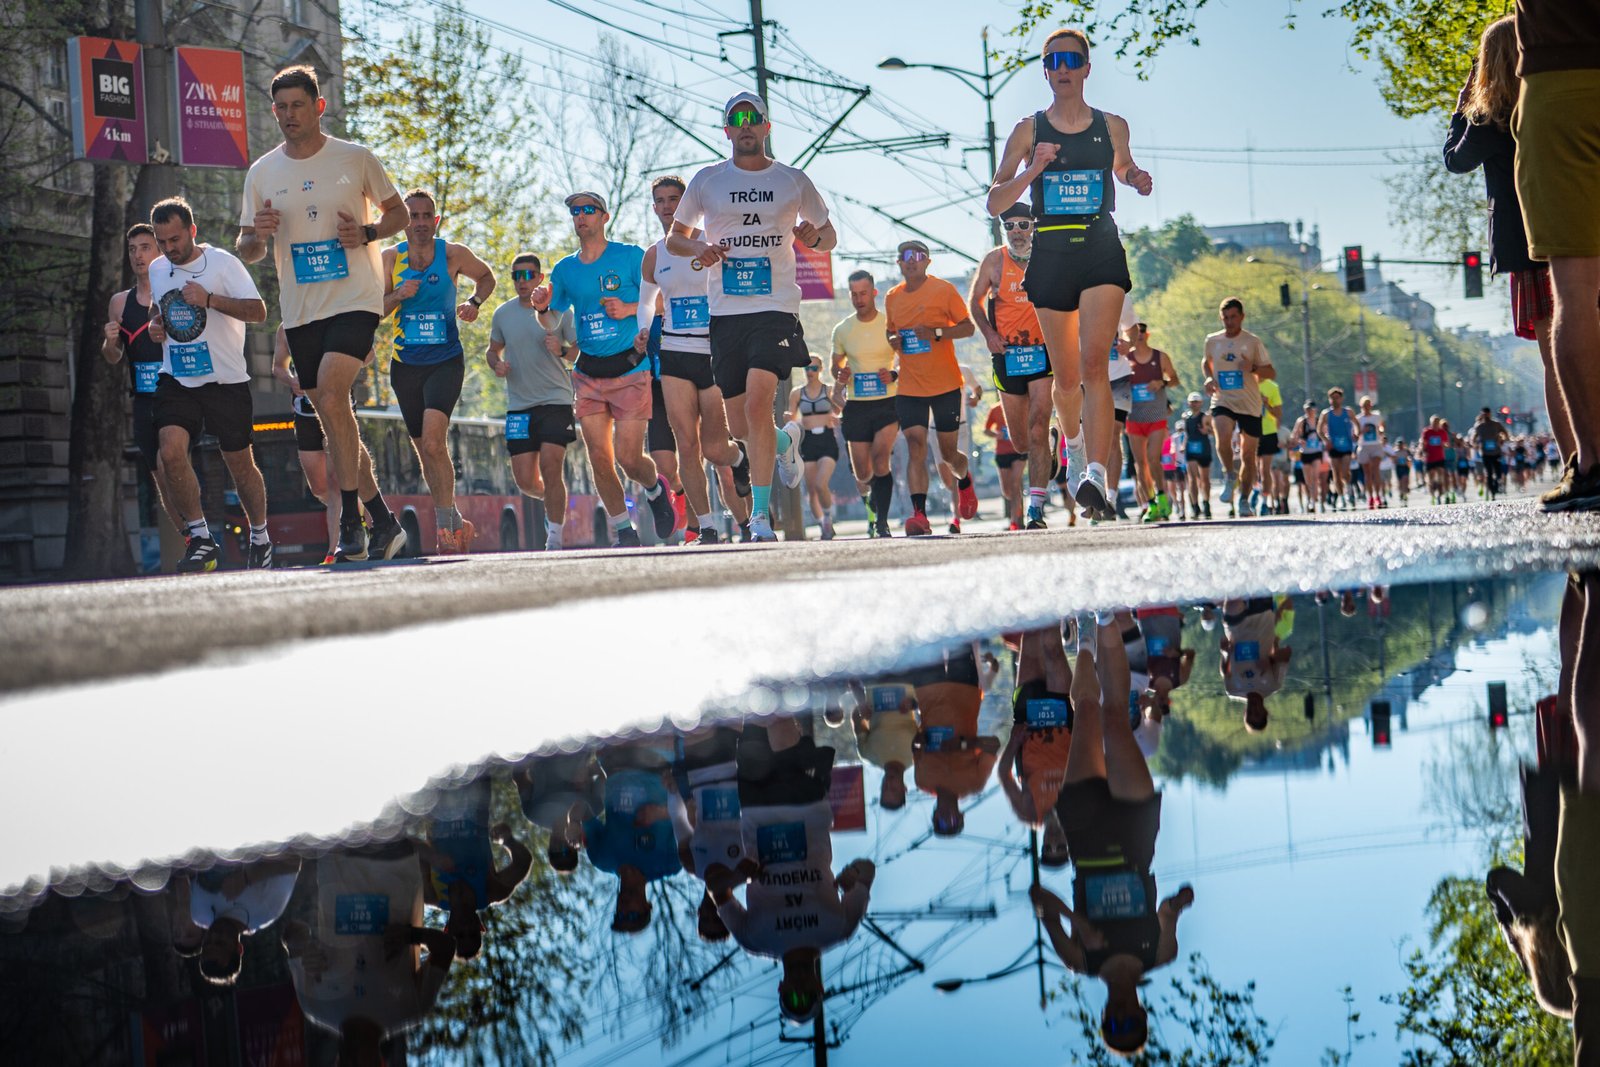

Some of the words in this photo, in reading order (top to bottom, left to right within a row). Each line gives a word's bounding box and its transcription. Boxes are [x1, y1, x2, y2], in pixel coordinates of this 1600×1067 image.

[99, 74, 130, 96] BIG
[100, 93, 131, 105] FASHION
[185, 82, 217, 101] ZARA
[221, 84, 241, 104] H&M
[185, 105, 242, 118] RESERVED
[104, 127, 132, 143] 4km
[729, 188, 774, 203] TRČIM
[1058, 185, 1089, 196] F1639
[742, 213, 762, 226] ZA
[719, 234, 783, 248] STUDENTE
[307, 255, 330, 266] 1352
[736, 271, 754, 280] 267
[685, 309, 698, 319] 72
[419, 322, 435, 330] 405
[1016, 354, 1034, 363] 1072
